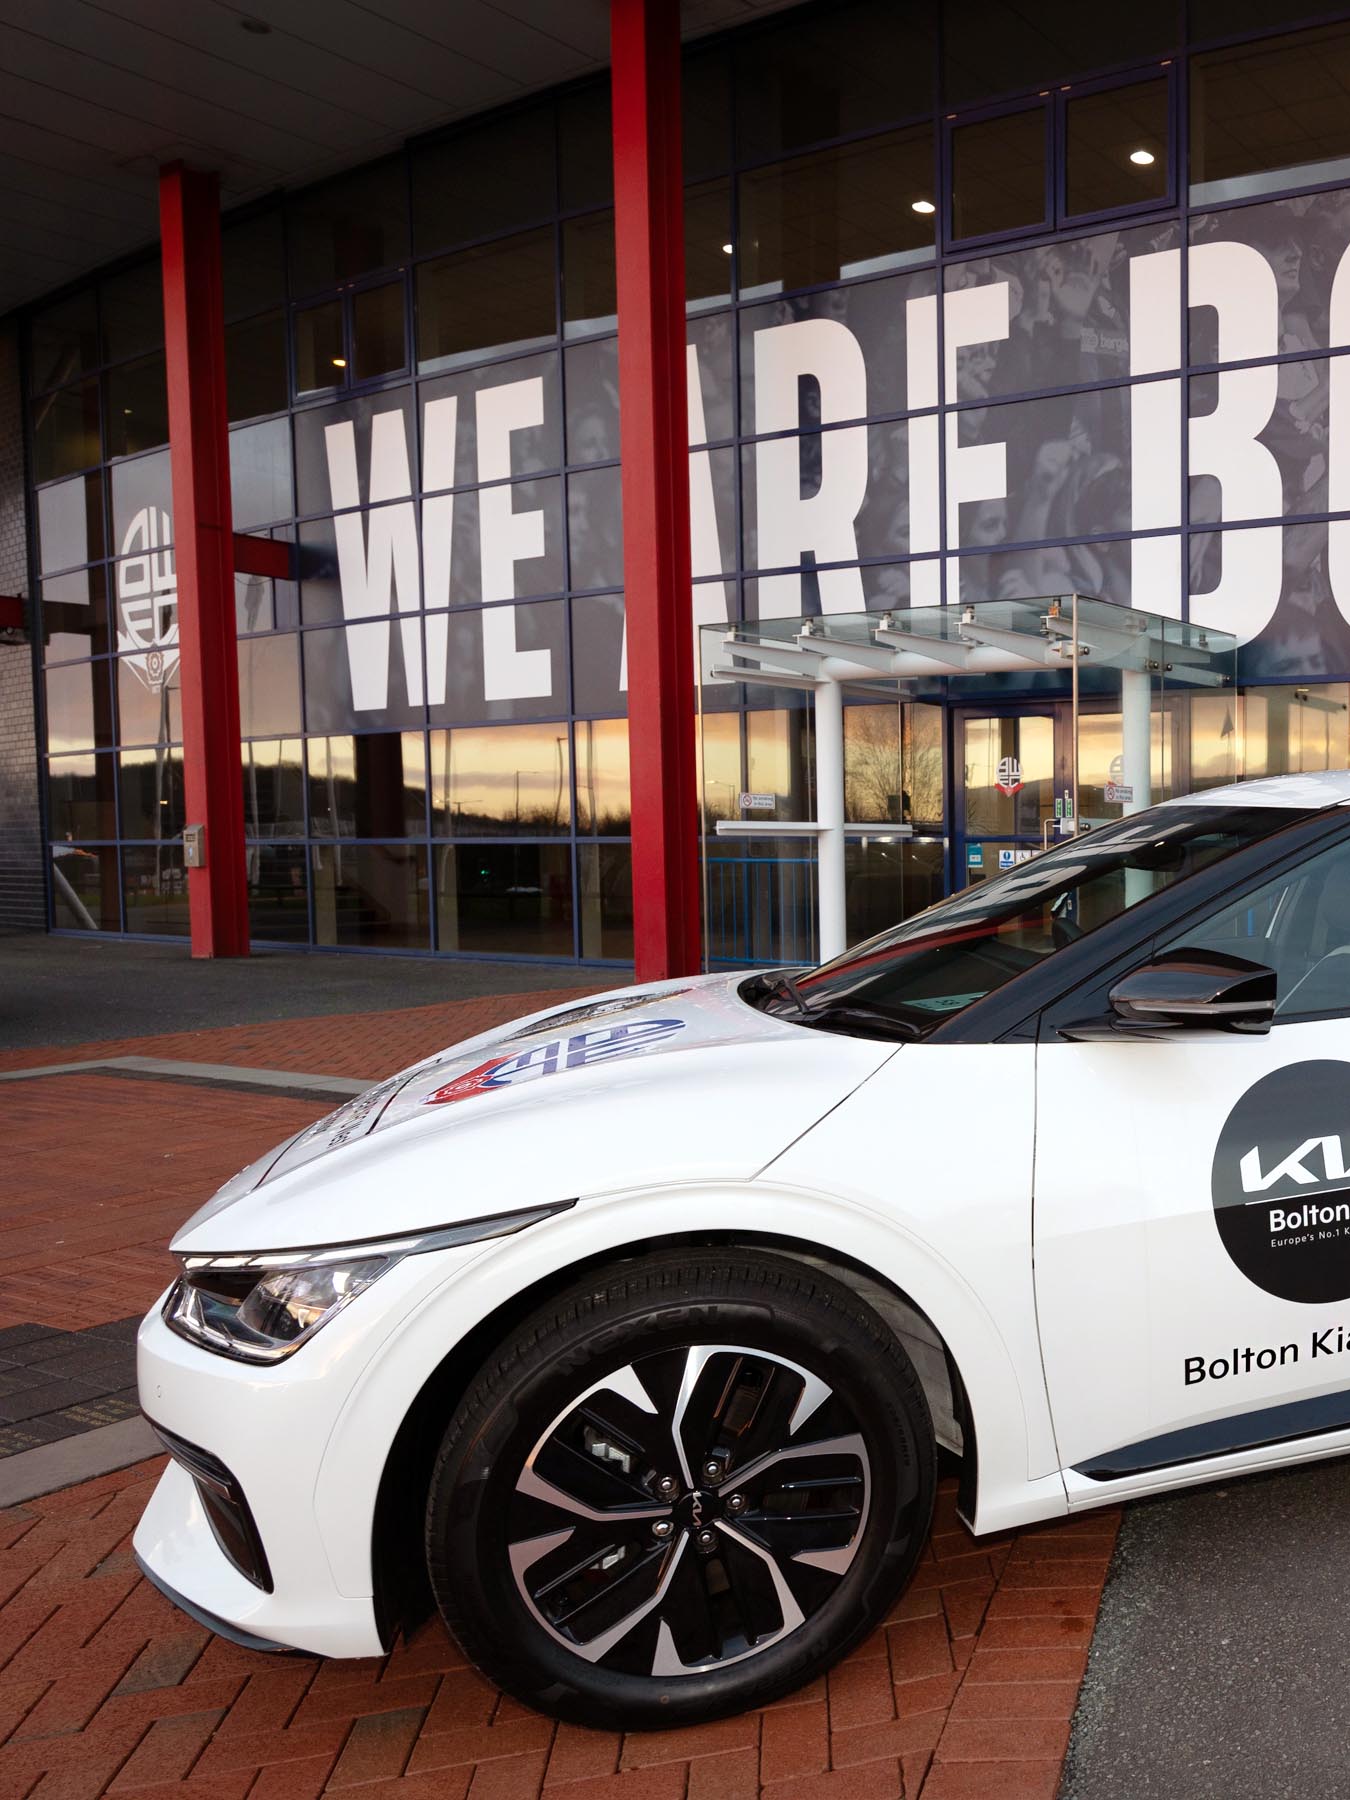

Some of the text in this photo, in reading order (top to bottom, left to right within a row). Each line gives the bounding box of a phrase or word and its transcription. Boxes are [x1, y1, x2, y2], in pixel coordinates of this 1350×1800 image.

[324, 376, 552, 712] WE
[1269, 1202, 1350, 1232] Bolton
[1270, 1232, 1315, 1248] Europe's
[1318, 1228, 1341, 1240] No.1
[1184, 1343, 1299, 1386] Bolton
